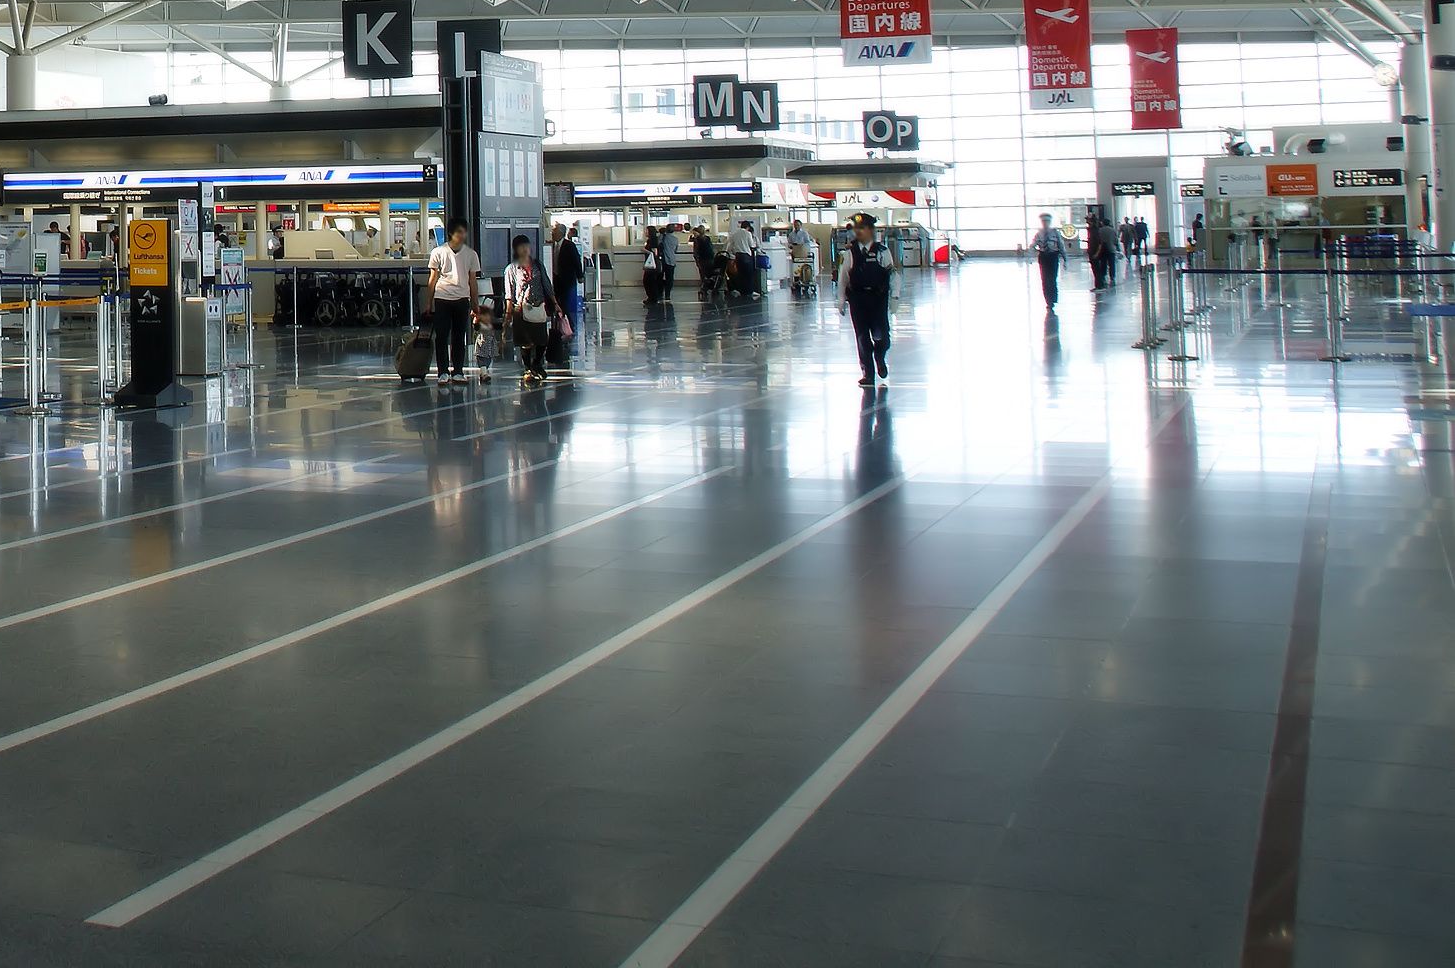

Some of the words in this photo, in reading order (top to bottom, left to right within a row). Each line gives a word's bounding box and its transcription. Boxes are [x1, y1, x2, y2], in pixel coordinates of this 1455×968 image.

[848, 0, 910, 12] Departures
[849, 12, 922, 33] 国内線
[356, 12, 399, 65] K
[454, 32, 476, 78] L
[858, 45, 894, 59] ANA
[1032, 56, 1070, 64] Domestic
[1032, 63, 1077, 72] Departures
[1033, 71, 1086, 86] 国内線
[698, 82, 734, 118] M
[1048, 90, 1074, 106] JAL
[742, 90, 771, 124] N
[866, 115, 893, 143] O
[896, 120, 912, 146] P
[95, 176, 117, 185] ANA
[299, 171, 322, 181] ANA
[219, 188, 224, 200] 1
[842, 192, 862, 206] JAL
[134, 267, 157, 275] Tickets
